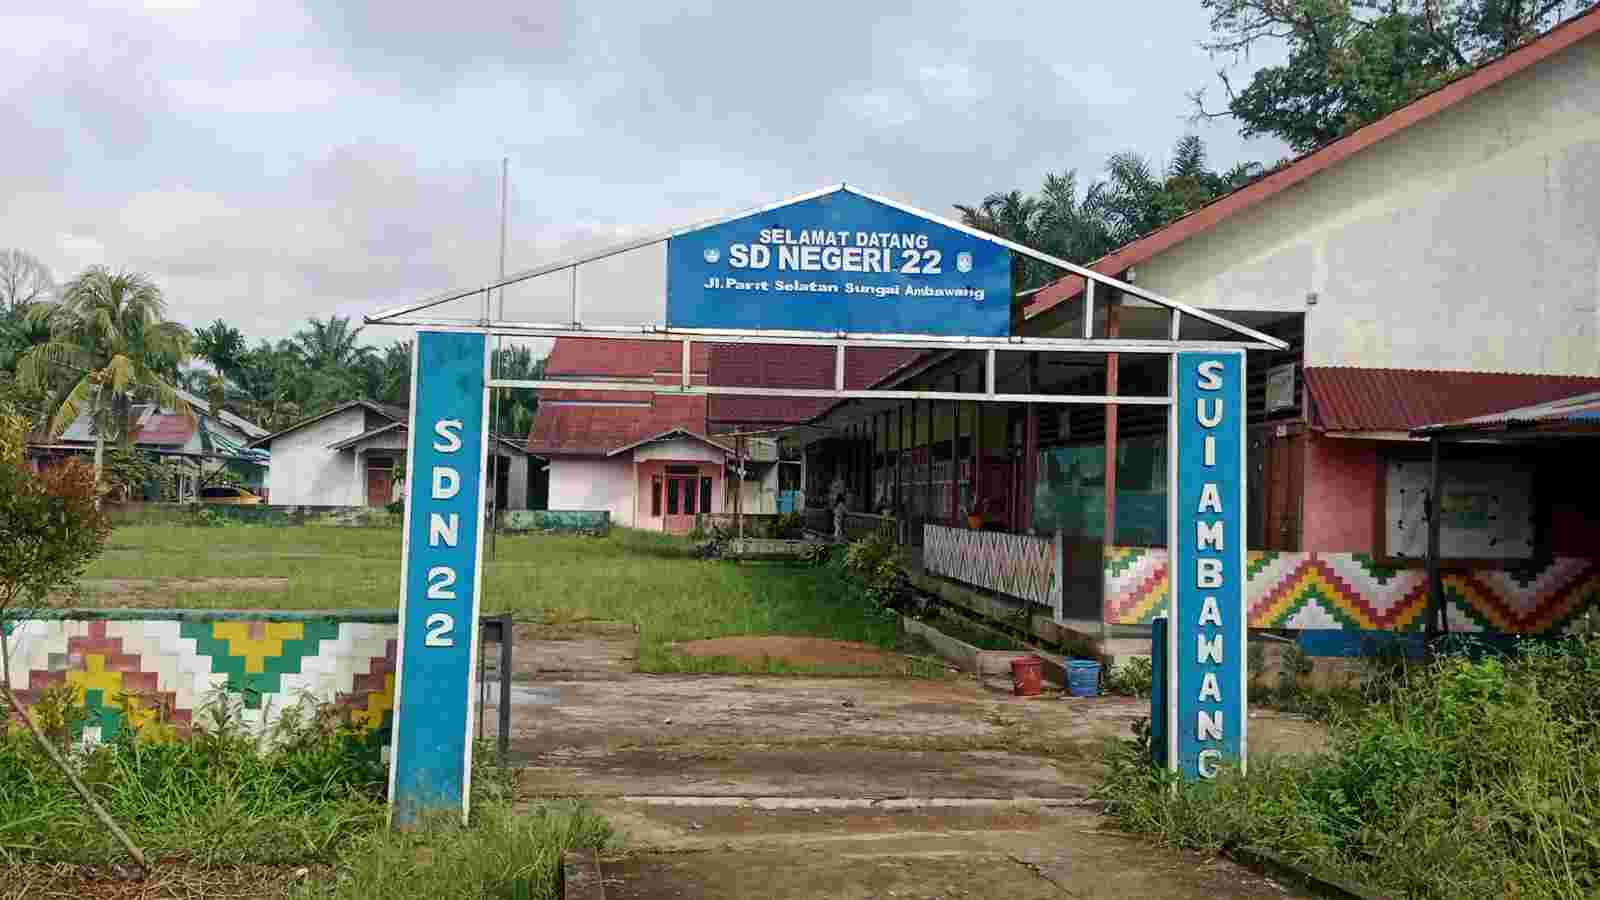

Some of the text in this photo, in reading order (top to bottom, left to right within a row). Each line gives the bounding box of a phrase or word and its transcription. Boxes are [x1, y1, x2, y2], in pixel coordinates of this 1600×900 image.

[759, 229, 929, 249] SELAMAT DATANG
[729, 243, 942, 274] SD NEGERI 22
[775, 279, 838, 293] Selatan
[845, 283, 900, 297] Sungai
[905, 285, 985, 301] Ambawang
[424, 418, 463, 648] SDN 22
[1196, 360, 1225, 778] SUI AMBAWANG
